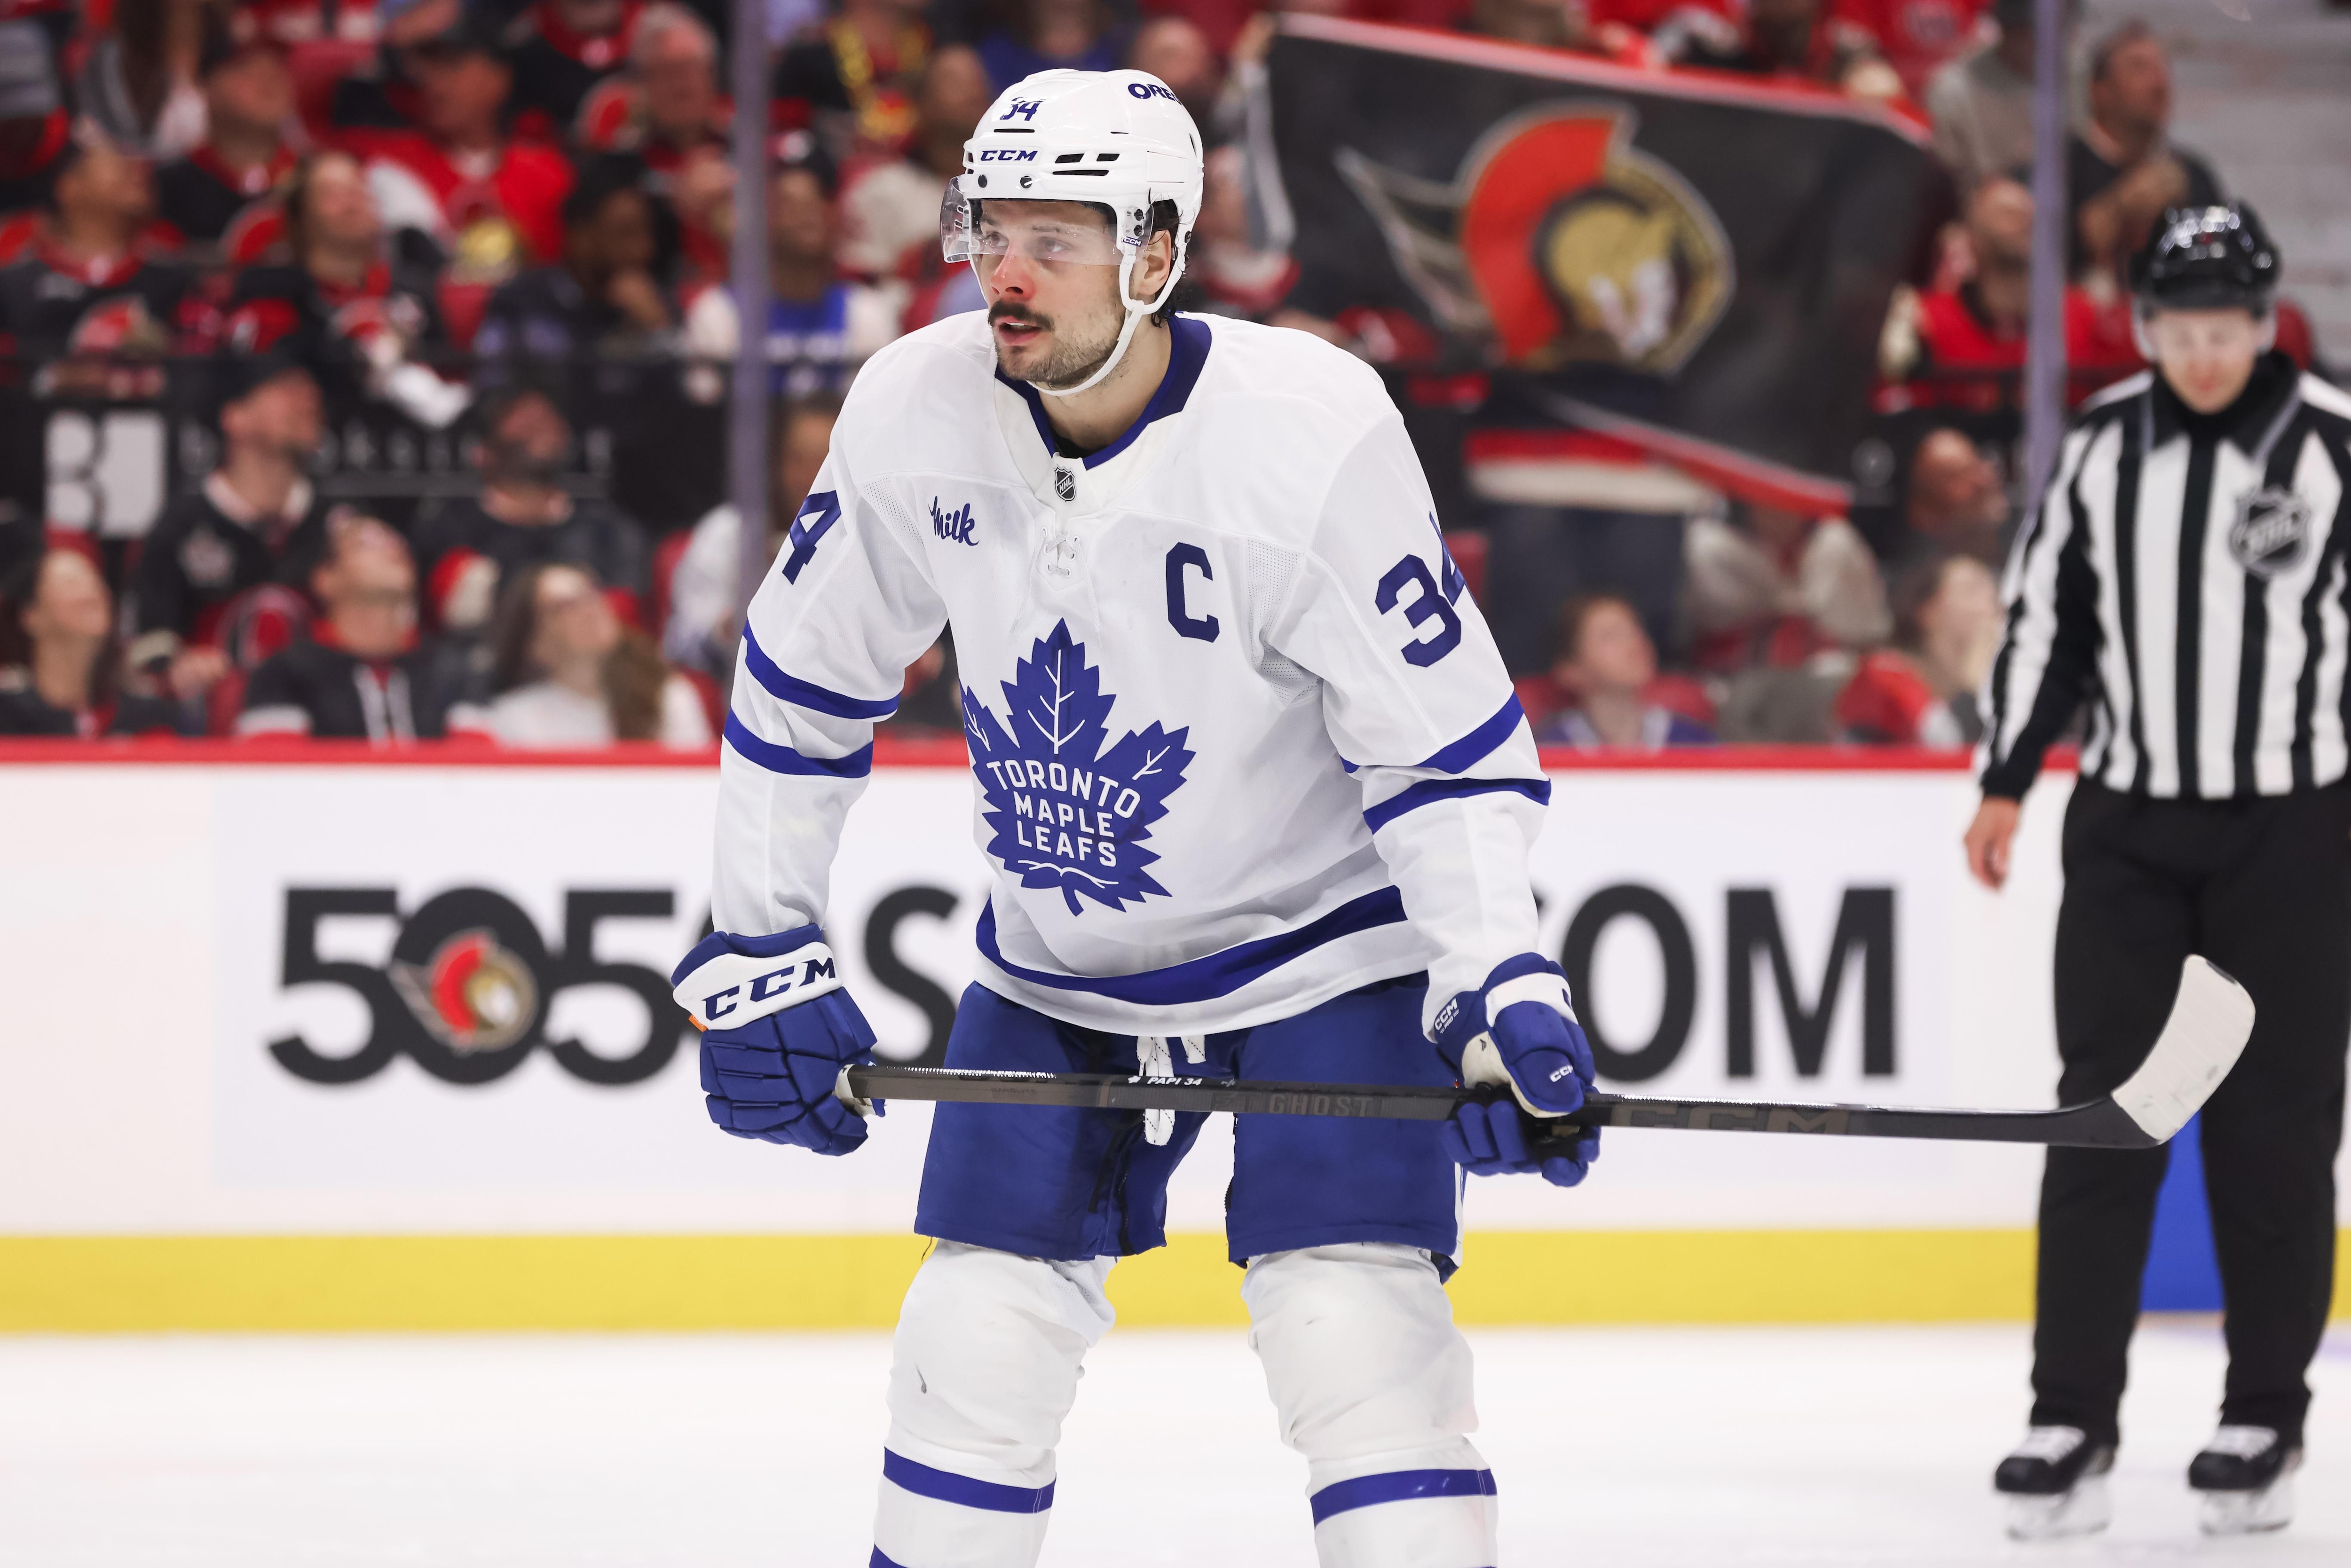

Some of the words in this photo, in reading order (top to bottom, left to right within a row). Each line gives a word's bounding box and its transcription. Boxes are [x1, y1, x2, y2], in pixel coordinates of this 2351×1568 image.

[980, 150, 1038, 161] CCM
[1124, 237, 1142, 246] CCM
[1059, 477, 1072, 494] NHL
[1166, 541, 1220, 643] C
[986, 759, 1141, 819] TORONTO
[1013, 791, 1115, 838] MAPLE
[1017, 820, 1117, 867] LEAFS
[702, 956, 836, 1021] CCM
[1435, 998, 1458, 1031] CCM
[1444, 1015, 1454, 1030] PRO
[1268, 1094, 1374, 1118] GHOST
[1612, 1103, 1851, 1134] CCM
